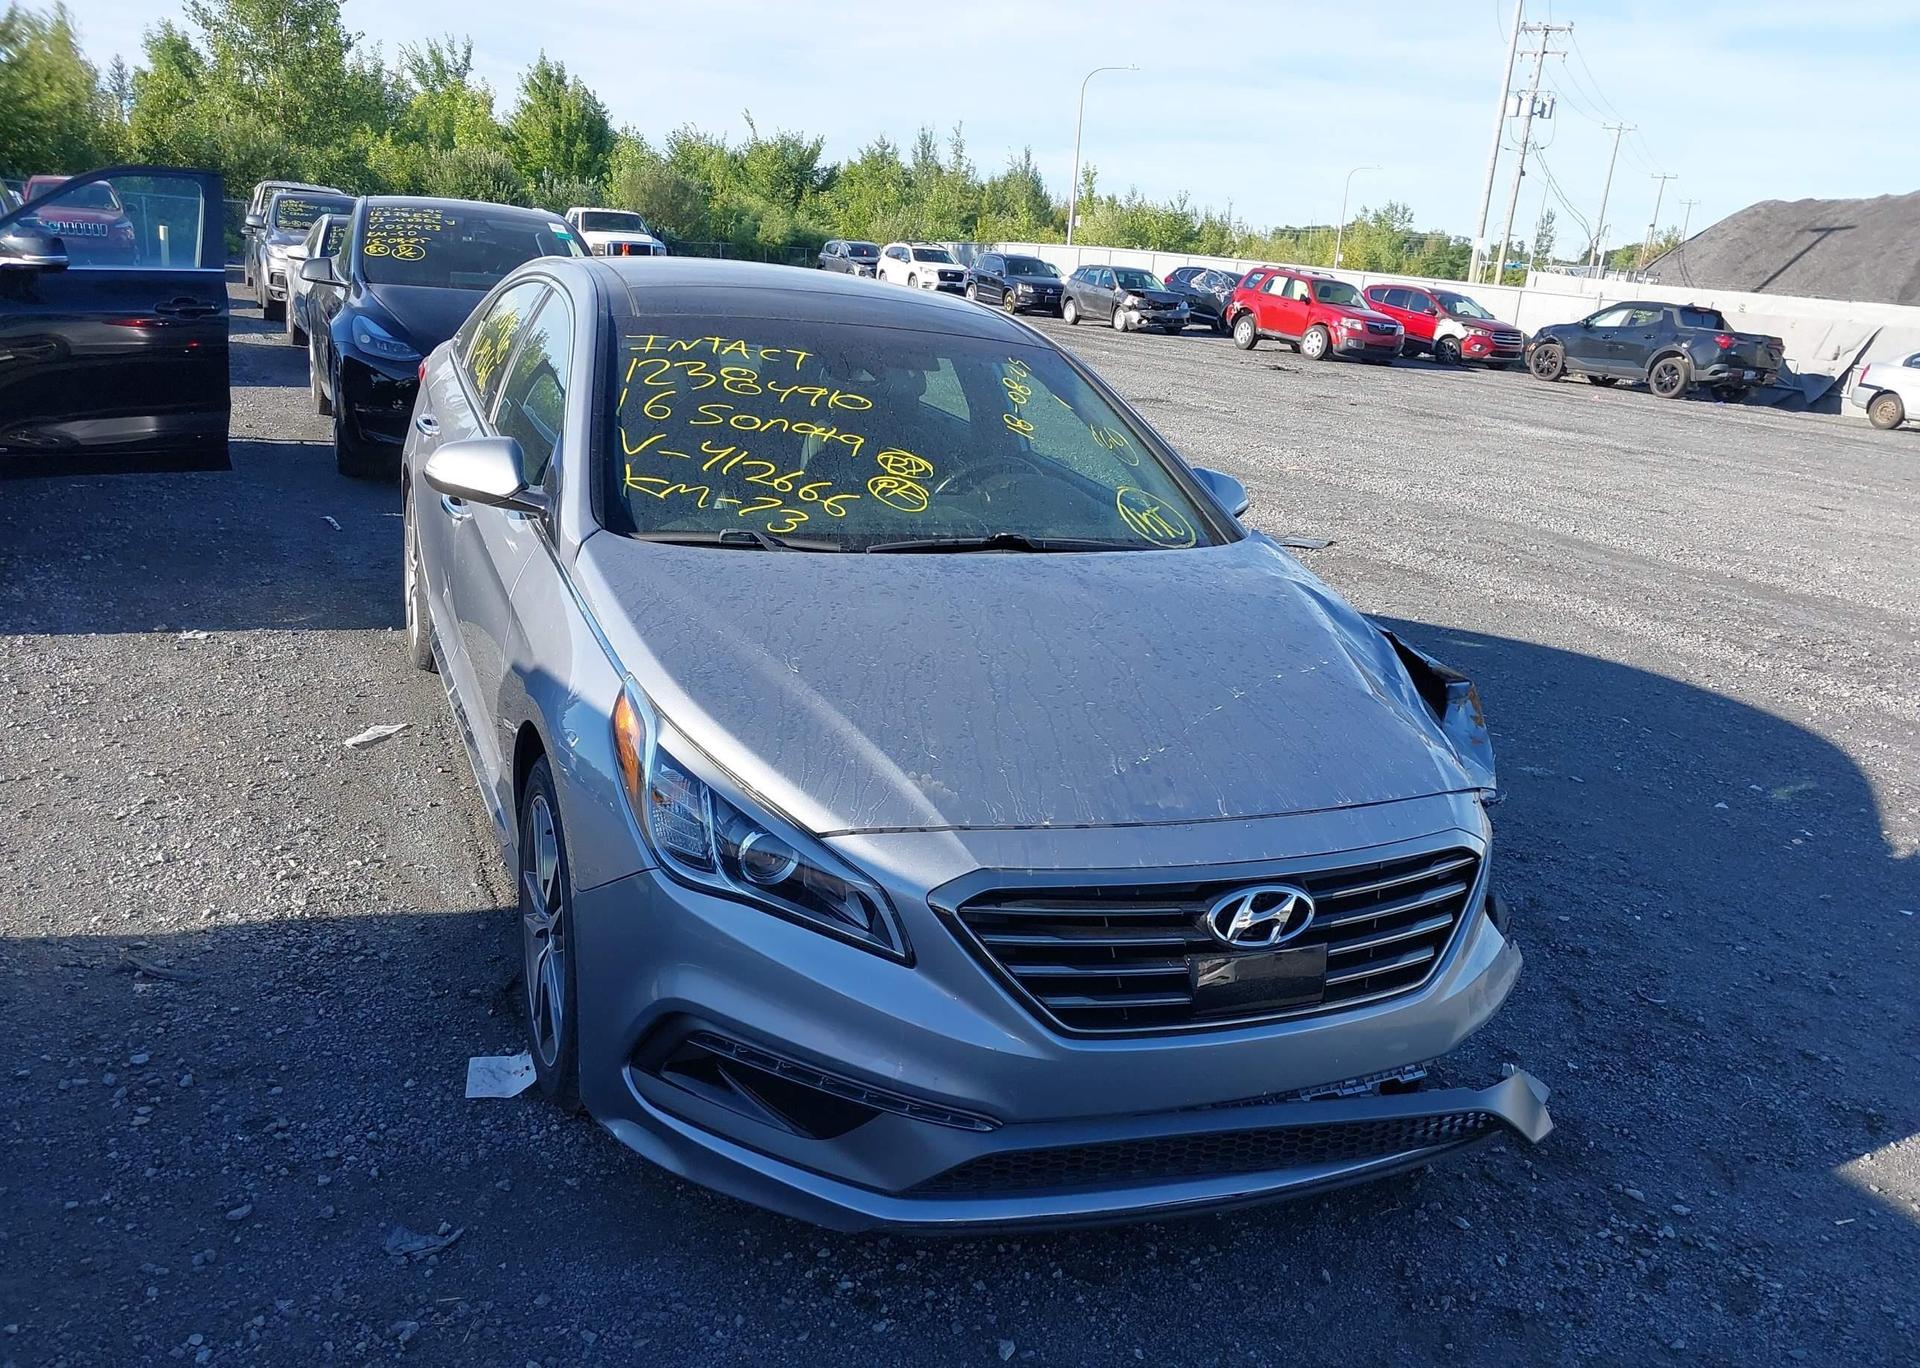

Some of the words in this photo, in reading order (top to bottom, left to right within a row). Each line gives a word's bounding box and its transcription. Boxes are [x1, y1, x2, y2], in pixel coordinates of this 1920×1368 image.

[625, 335, 814, 371] INTACT
[625, 357, 873, 410] 1238490
[617, 388, 677, 420] 16
